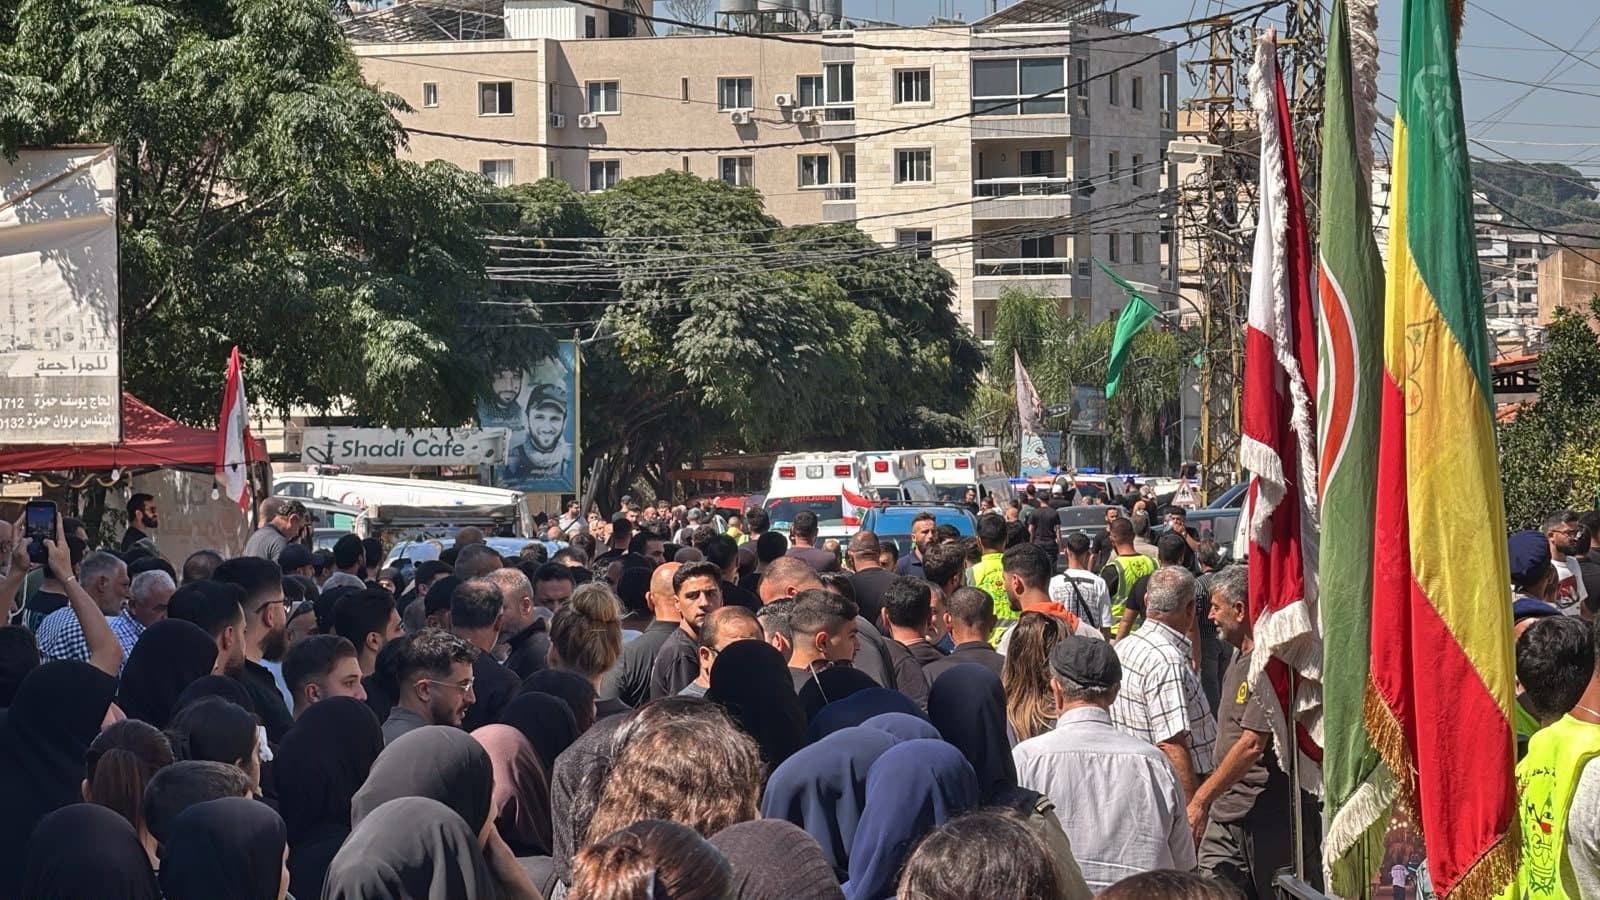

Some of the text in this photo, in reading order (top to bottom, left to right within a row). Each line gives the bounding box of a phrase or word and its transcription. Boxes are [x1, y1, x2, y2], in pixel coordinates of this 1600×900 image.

[37, 355, 108, 374] للمراجعة
[34, 393, 58, 409] حمزة
[60, 393, 88, 409] يوسف
[89, 394, 115, 409] الحاج
[27, 412, 51, 429] حمزة
[53, 414, 79, 428] مروان
[80, 412, 115, 428] المهندس
[341, 439, 465, 458] Shadi Cafe
